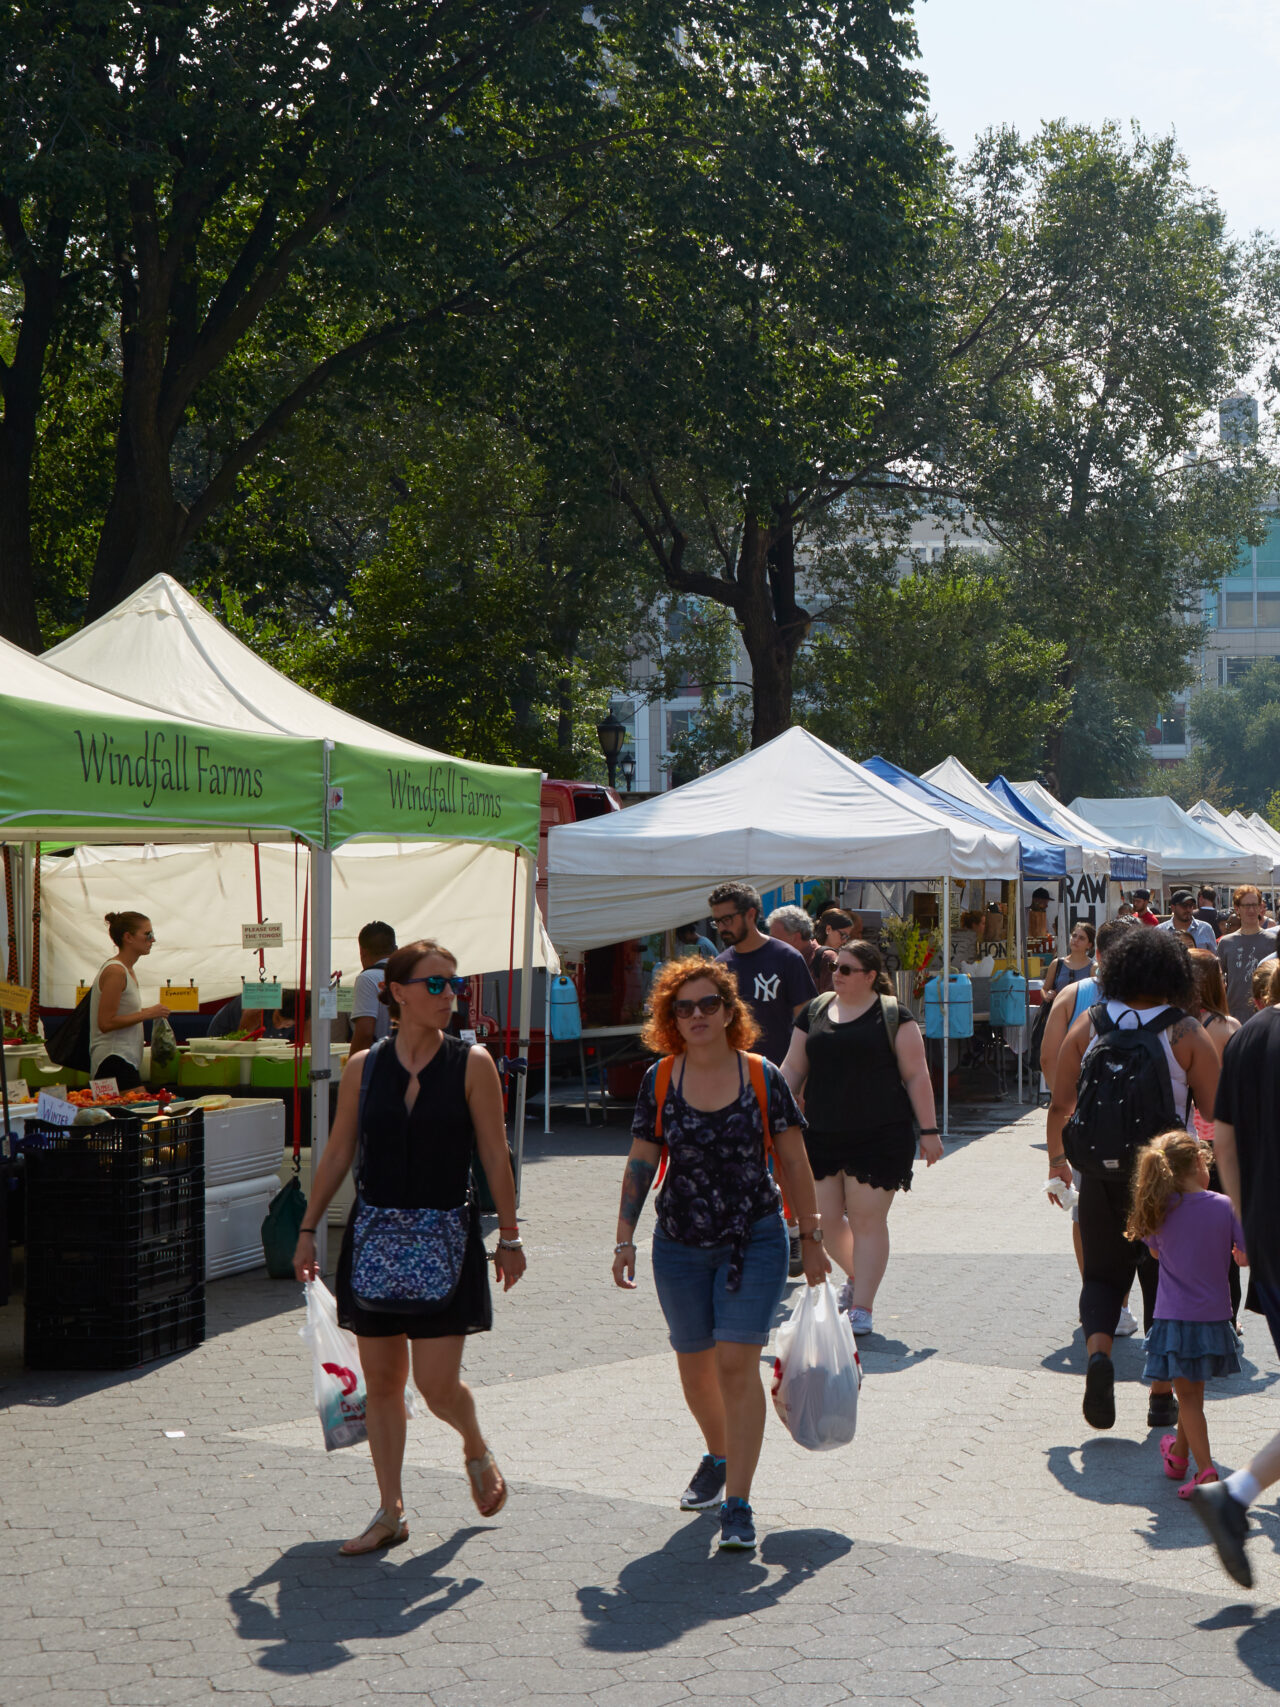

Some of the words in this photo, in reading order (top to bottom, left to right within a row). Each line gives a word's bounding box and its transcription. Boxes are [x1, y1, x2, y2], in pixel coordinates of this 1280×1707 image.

[74, 729, 190, 808] Windfall
[194, 745, 264, 799] Farms
[387, 765, 457, 828] Windfall
[459, 776, 502, 819] Farms
[1059, 873, 1107, 903] RAW
[753, 972, 782, 1002] NY
